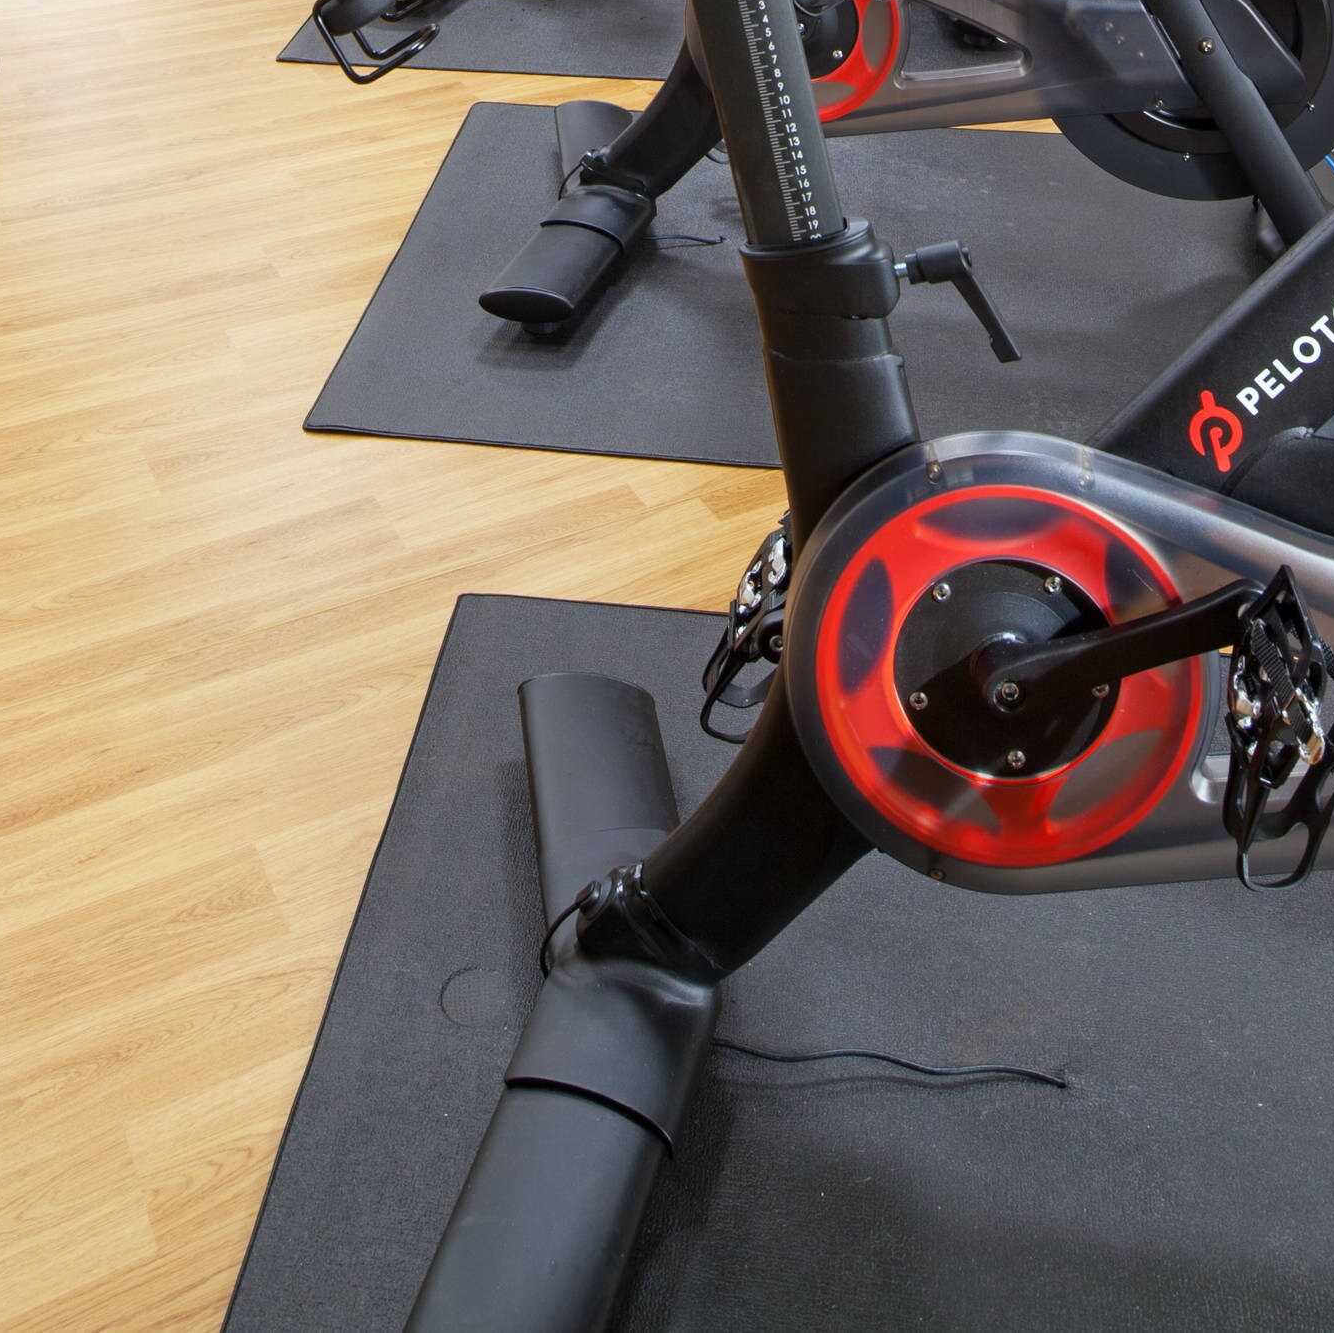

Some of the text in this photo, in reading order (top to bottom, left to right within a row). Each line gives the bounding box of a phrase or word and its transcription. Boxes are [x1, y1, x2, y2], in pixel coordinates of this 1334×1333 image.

[758, 0, 766, 10] 3
[762, 14, 769, 23] 4
[765, 27, 772, 37] 5
[768, 41, 775, 51] 6
[771, 54, 777, 65] 7
[774, 68, 782, 78] 8
[777, 82, 784, 92] 9
[779, 95, 791, 106] 10
[782, 108, 792, 119] 11
[785, 123, 797, 133] 12
[788, 136, 800, 147] 13
[791, 150, 804, 161] 14
[795, 165, 807, 176] 15
[798, 179, 810, 189] 16
[801, 192, 812, 202] 17
[805, 206, 817, 217] 18
[808, 220, 819, 231] 19
